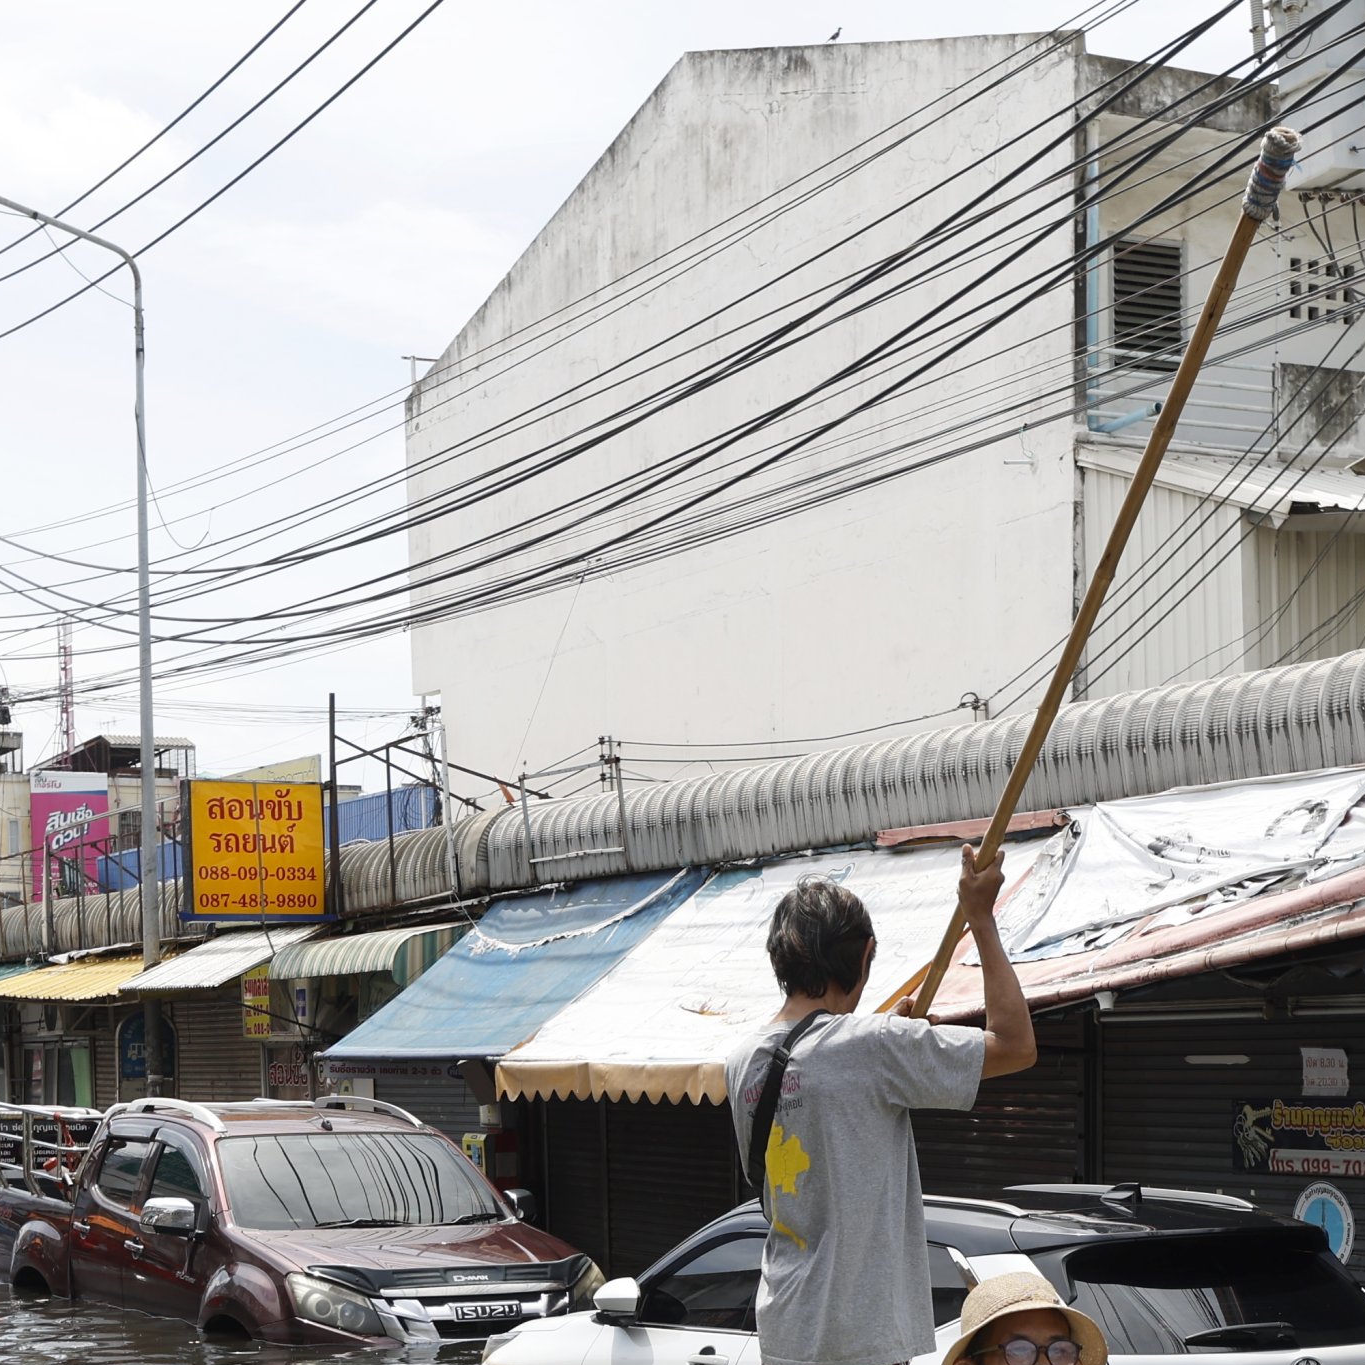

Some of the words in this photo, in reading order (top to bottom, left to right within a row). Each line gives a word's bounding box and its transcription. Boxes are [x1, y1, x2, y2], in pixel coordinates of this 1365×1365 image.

[206, 789, 303, 821] สอนขับ
[209, 823, 297, 853] รถยนต์
[198, 865, 317, 881] 088-090-0334
[199, 893, 317, 908] 087-488-9890
[456, 1304, 517, 1320] ISUZU
